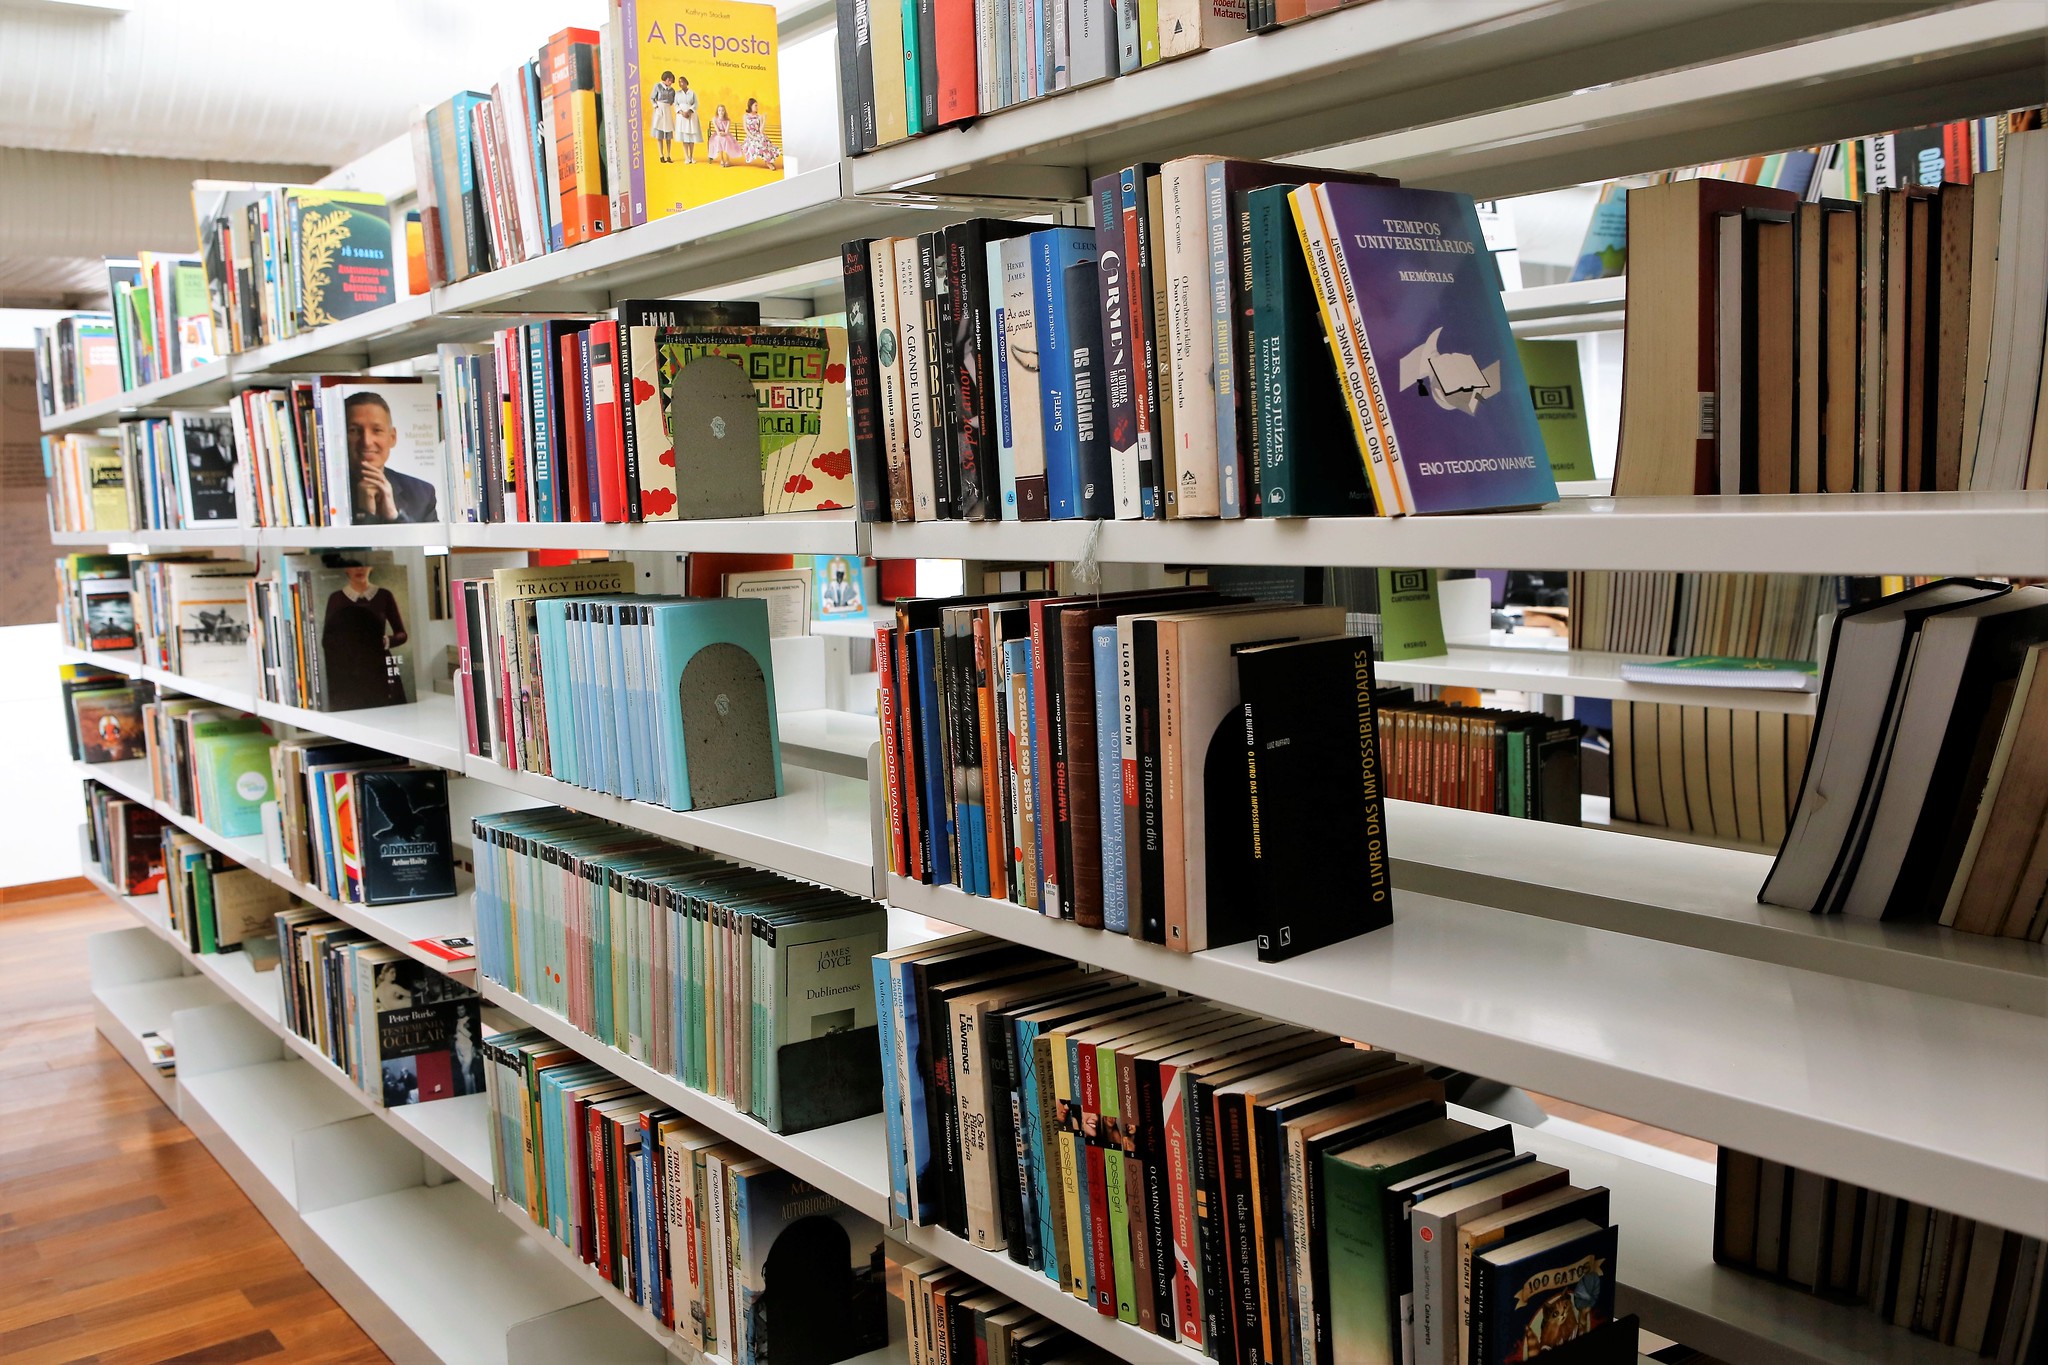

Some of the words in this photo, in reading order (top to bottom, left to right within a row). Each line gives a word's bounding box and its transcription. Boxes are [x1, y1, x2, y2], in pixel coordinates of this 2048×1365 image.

[685, 8, 707, 19] Kathryn
[708, 9, 731, 20] Stockett
[647, 20, 667, 45] A
[674, 22, 770, 58] Resposta
[628, 62, 637, 79] A
[715, 60, 740, 69] Histórias
[740, 61, 767, 71] Cruzadas
[628, 84, 640, 170] Resposta
[1211, 188, 1222, 221] VISITA
[1212, 224, 1224, 257] CRUEL
[1382, 218, 1441, 236] TEMPOS
[1354, 234, 1475, 255] UNIVERSITÁRIOS
[843, 264, 864, 276] Castro
[847, 253, 859, 264] Ruy
[1214, 261, 1225, 275] DO
[1312, 239, 1338, 306] Memórias/4
[1398, 269, 1455, 283] MEMÓRIAS
[1100, 250, 1124, 366] CARMEN
[1215, 278, 1226, 314] TEMPO
[641, 311, 676, 327] EMMA
[906, 323, 915, 333] A
[665, 335, 692, 344] Arthur
[695, 335, 741, 345] Nestrovski
[856, 345, 863, 355] A
[1217, 319, 1230, 365] JENNIFER
[1335, 323, 1355, 370] WANKE
[1353, 316, 1372, 364] WANKE
[531, 350, 542, 360] O
[582, 340, 591, 382] FAULKNER
[851, 355, 868, 367] noite
[907, 336, 919, 389] GRANDE
[925, 300, 942, 428] HEBE
[1073, 347, 1090, 368] OS
[1262, 339, 1270, 372] VISTOS
[1270, 336, 1281, 379] ELES,
[854, 377, 868, 387] meu
[856, 366, 865, 376] do
[1219, 369, 1230, 395] EGAN
[531, 363, 546, 423] FUTURO
[855, 387, 869, 397] bem
[1265, 395, 1272, 410] UM
[1273, 383, 1282, 404] OS
[1349, 371, 1375, 434] TEODORO
[1367, 366, 1390, 430] TEODORO
[621, 349, 630, 376] HEALEY
[626, 430, 635, 478] ELIZABETH?
[911, 392, 924, 439] ILUSÃO
[1075, 371, 1095, 442] LUSÍADAS
[1273, 408, 1285, 467] JUÍZES,
[1368, 436, 1383, 464] ENO
[1386, 435, 1399, 463] ENO
[534, 424, 549, 480] CHEGOU
[1419, 462, 1444, 476] ENO
[1444, 459, 1497, 475] TEODORO
[1498, 456, 1536, 471] WANKE
[516, 581, 571, 596] TRACY
[575, 578, 622, 592] HOGG
[1122, 643, 1131, 687] LUGAR
[883, 688, 891, 715] ENO
[1244, 703, 1252, 717] LUIZ
[1018, 687, 1029, 746] bronzes
[1124, 695, 1132, 746] COMUM
[1354, 649, 1377, 801] IMPOSSIBILIDADES
[1111, 731, 1119, 759] FLOR
[1246, 718, 1254, 746] RUFFATO
[1266, 741, 1275, 750] LUIZ
[1275, 738, 1290, 748] RUFFATO
[885, 719, 897, 784] TEODORO
[1021, 749, 1030, 776] dos
[1144, 756, 1153, 768] as
[1112, 763, 1121, 780] EM
[1248, 758, 1256, 779] LIVRO
[1023, 778, 1033, 814] casa
[1057, 761, 1068, 823] VAMPIROS
[1145, 769, 1154, 813] marcas
[890, 787, 901, 835] WANKE
[1025, 815, 1034, 823] a
[1112, 783, 1123, 848] RAPARIGAS
[1146, 814, 1154, 827] no
[1365, 803, 1381, 836] DAS
[1146, 828, 1157, 851] divã
[1251, 796, 1262, 859] IMPOSSIBILIDADES
[392, 858, 410, 867] Arthur
[409, 857, 428, 866] Hailey
[1027, 842, 1037, 871] QUEEN
[1115, 848, 1124, 869] DAS
[1368, 839, 1384, 888] LIVRO
[1027, 873, 1038, 898] ELLERY
[1115, 871, 1125, 916] SOMBRA
[1372, 890, 1385, 902] O
[1116, 919, 1125, 928] A
[817, 956, 852, 973] JOYCE
[819, 946, 850, 960] JAMES
[806, 982, 861, 1001] Dublinenses
[388, 1014, 411, 1024] Peter
[411, 1009, 437, 1020] Burke
[383, 1029, 445, 1049] OCULAR
[959, 1013, 970, 1075] LAWRENCE
[962, 1095, 969, 1109] da
[970, 1114, 978, 1148] Pilares
[976, 1113, 985, 1126] Os
[1171, 1125, 1181, 1137] A
[962, 1110, 971, 1162] Sabedoria
[978, 1127, 986, 1151] Sete
[667, 1147, 675, 1182] CARLOS
[1060, 1137, 1072, 1176] gossip
[1150, 1166, 1157, 1174] O
[1171, 1138, 1183, 1181] garota
[1064, 1176, 1075, 1193] girl
[1107, 1155, 1120, 1196] gossip
[675, 1186, 683, 1228] NOSTRA
[712, 1168, 721, 1223] HOBSBAWM
[1112, 1196, 1123, 1214] girl
[1151, 1177, 1161, 1225] CAMINHO
[1236, 1194, 1248, 1221] todas
[1176, 1183, 1188, 1248] americana
[1239, 1223, 1247, 1232] as
[1154, 1226, 1162, 1245] DOS
[1240, 1234, 1250, 1264] coisas
[1156, 1249, 1167, 1297] INGLESES
[1182, 1260, 1191, 1281] MEG
[1240, 1266, 1251, 1286] que
[1528, 1277, 1550, 1295] 100
[1554, 1262, 1592, 1285] GATOS
[1183, 1285, 1193, 1318] CABOT
[1244, 1288, 1251, 1299] eu
[1244, 1301, 1255, 1312] já
[1247, 1314, 1257, 1327] fiz
